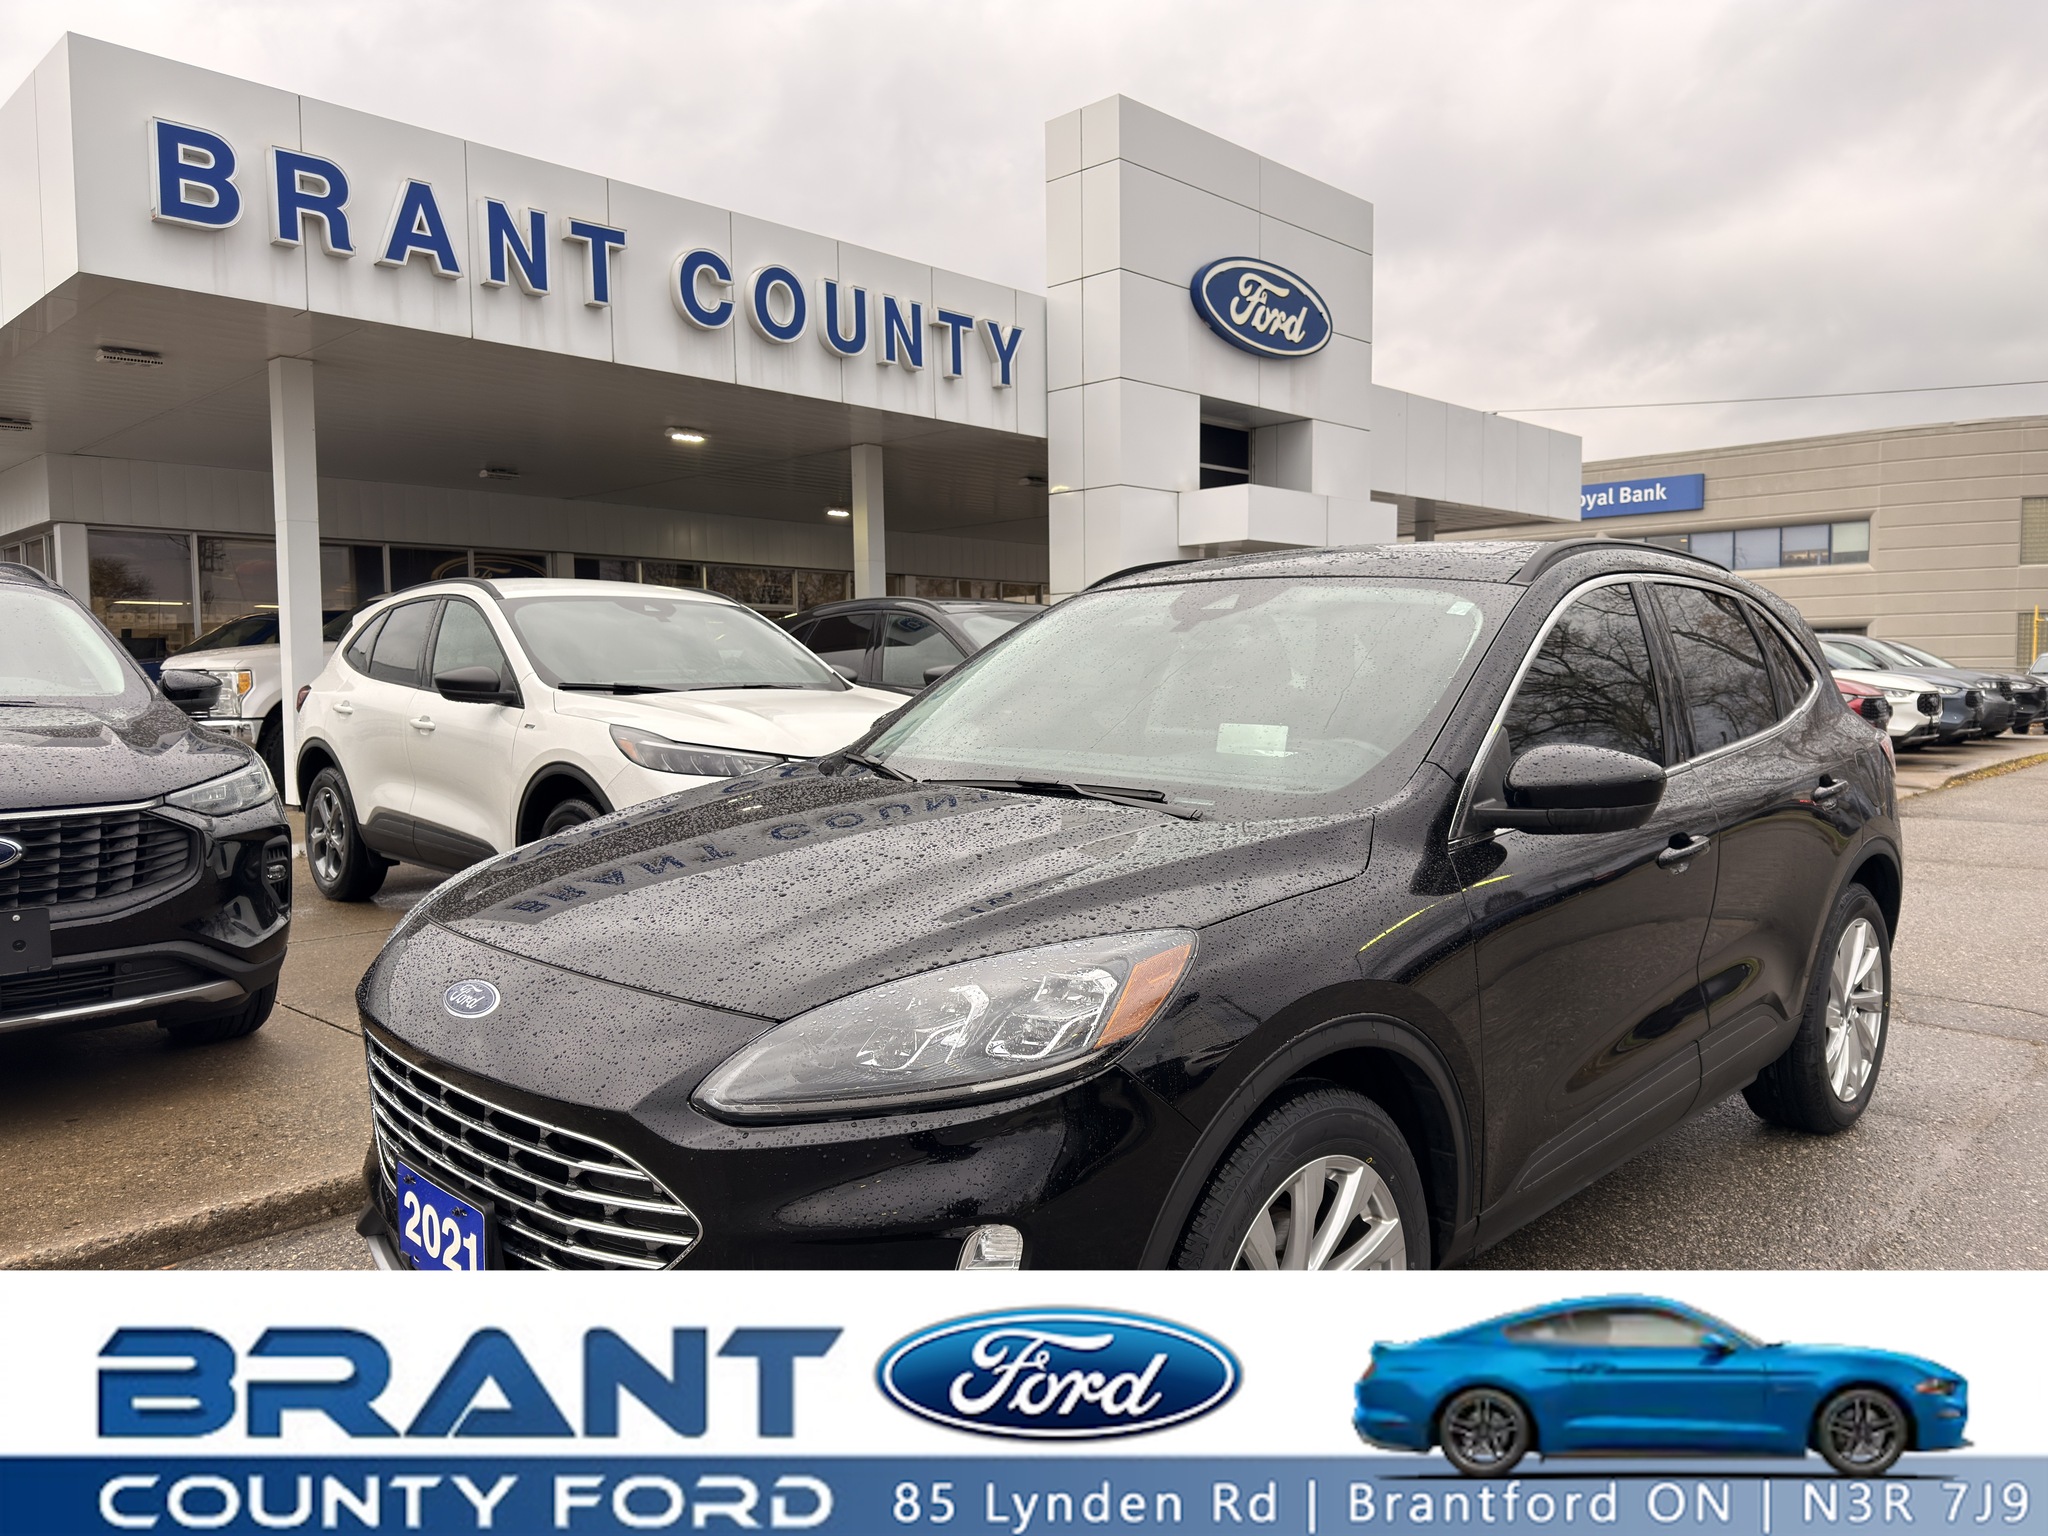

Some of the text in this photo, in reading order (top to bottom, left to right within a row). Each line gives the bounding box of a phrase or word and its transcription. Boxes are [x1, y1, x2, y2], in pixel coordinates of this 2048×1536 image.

[148, 116, 1026, 389] BRANT COUNTY
[1230, 272, 1308, 343] Ford
[1580, 483, 1667, 511] oyal Bank
[450, 984, 485, 1009] Ford
[404, 1190, 477, 1271] 2021
